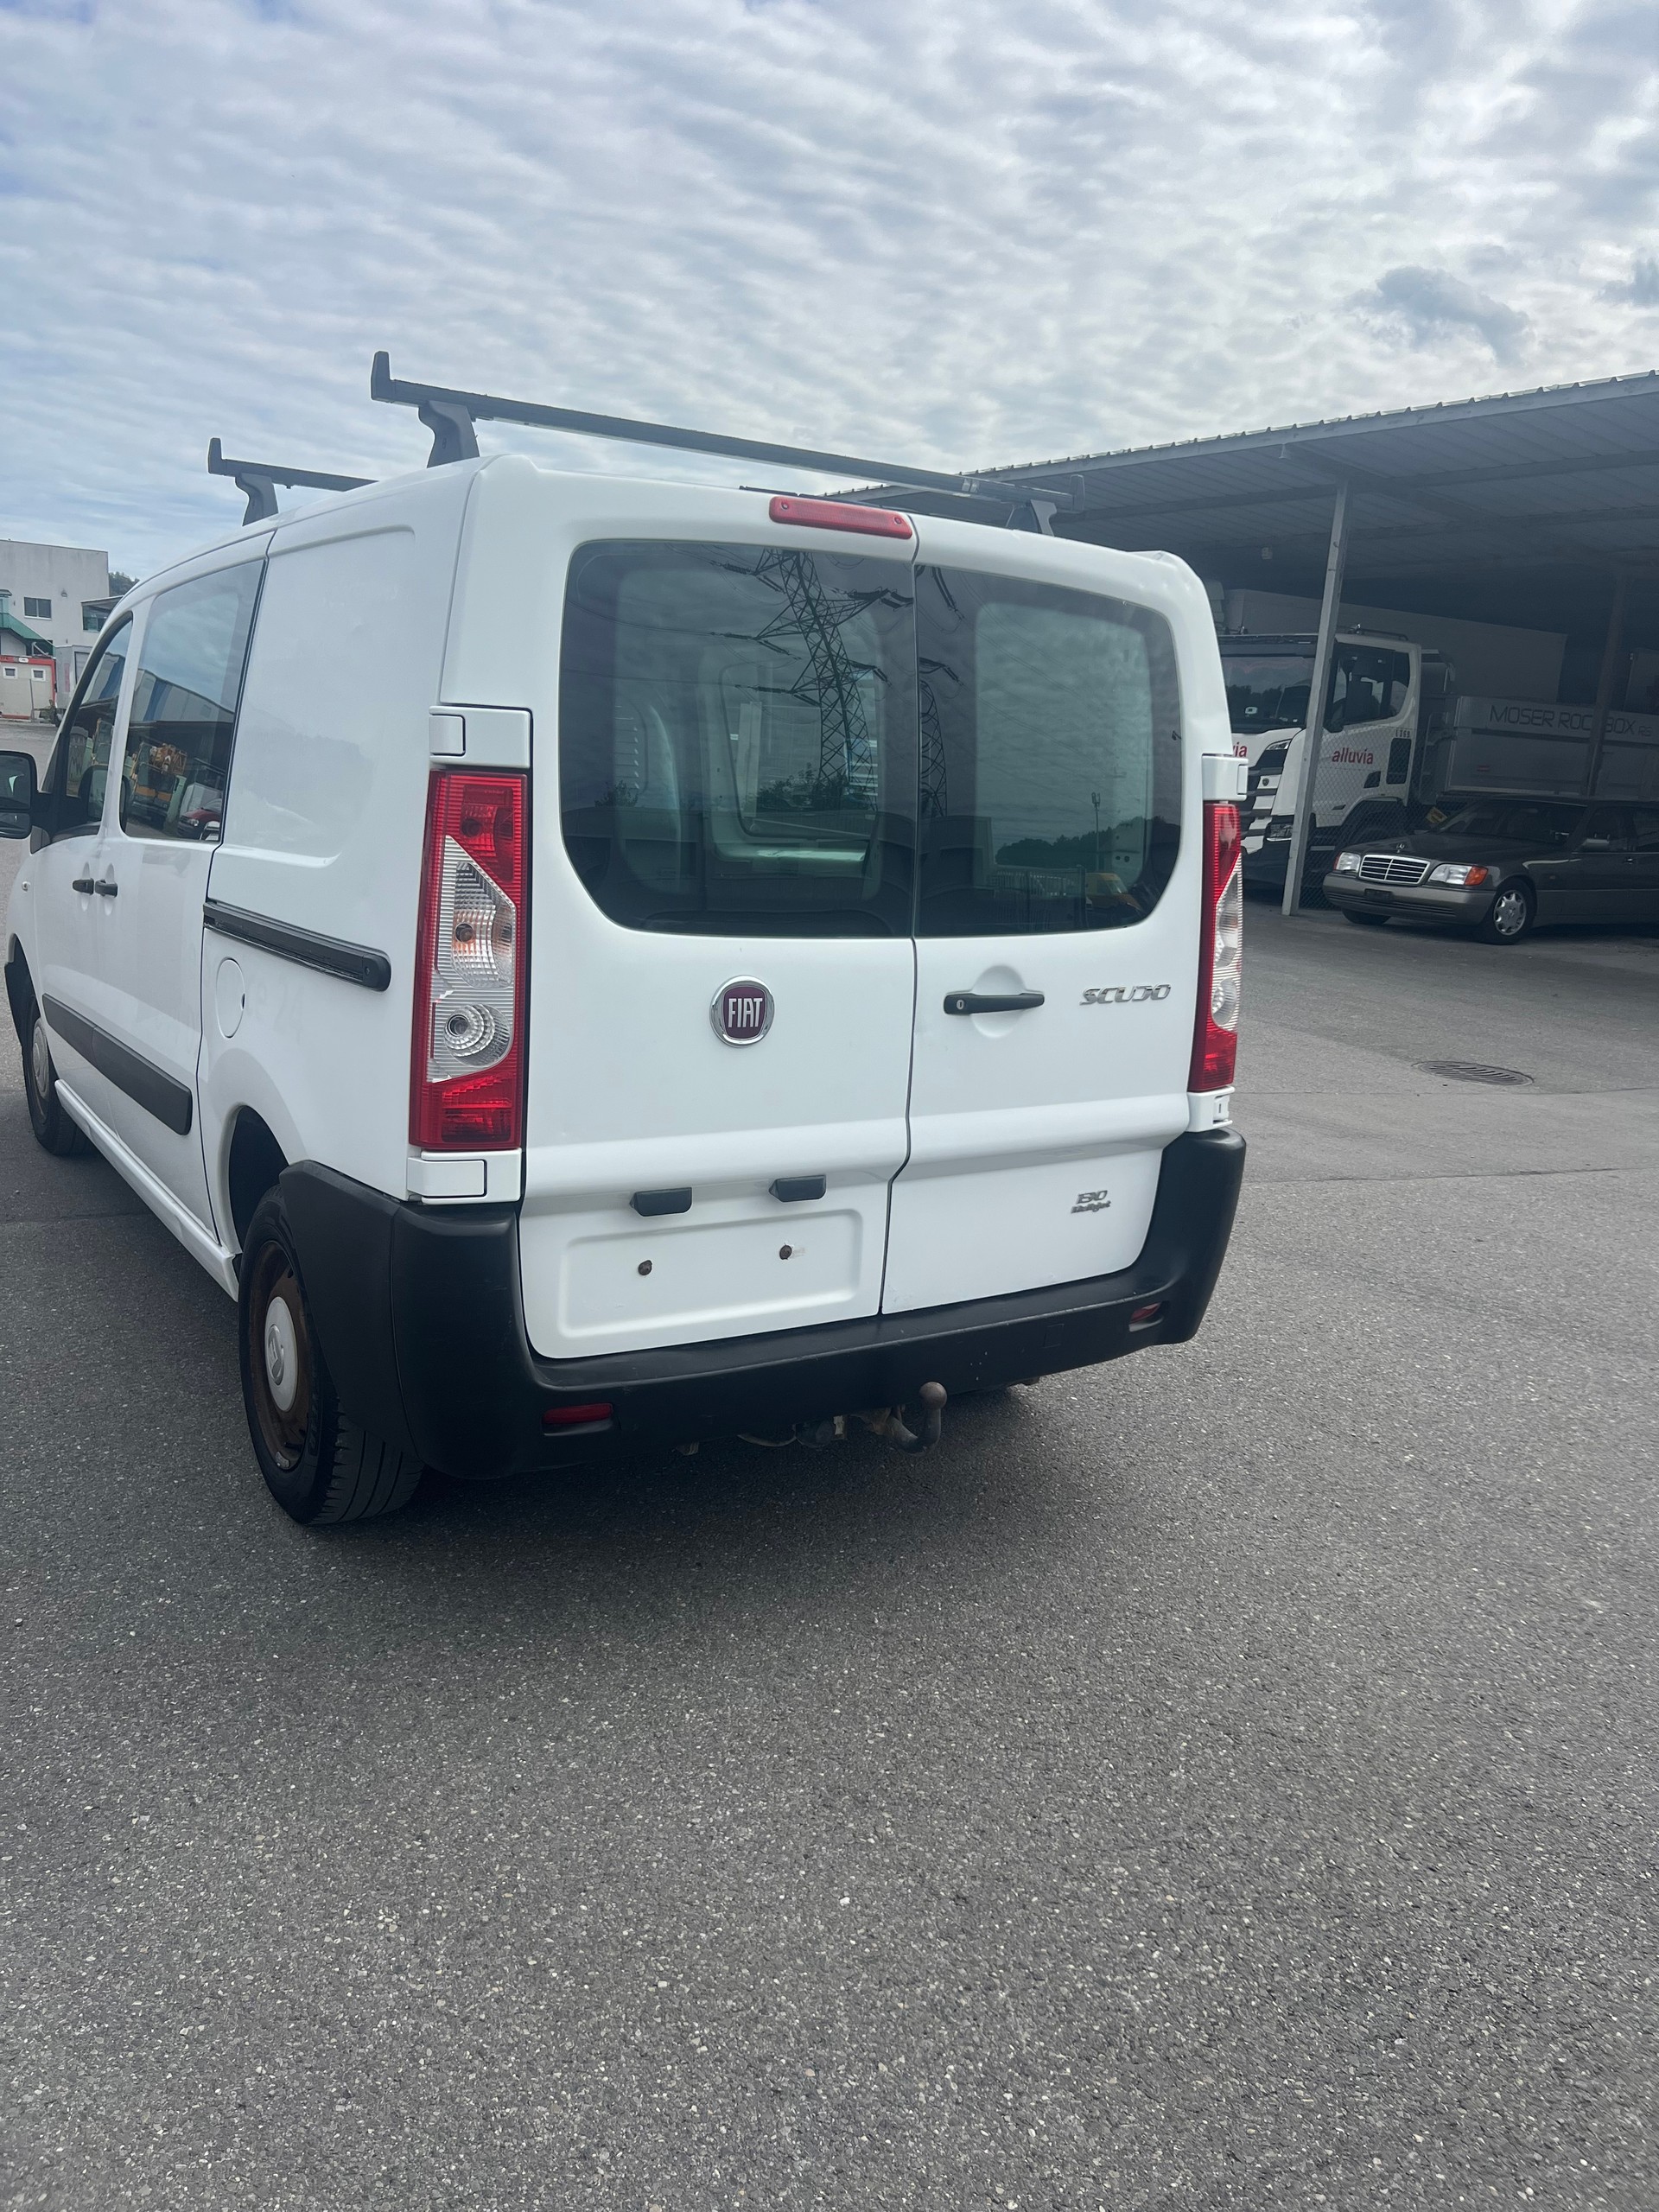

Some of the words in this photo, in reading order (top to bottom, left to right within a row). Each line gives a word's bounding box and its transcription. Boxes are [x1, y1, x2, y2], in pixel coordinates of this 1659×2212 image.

[1490, 705, 1554, 728] MOSER
[1558, 711, 1636, 734] ROCBOX
[1332, 747, 1374, 765] alluvia
[1079, 984, 1171, 1005] SCUDO
[728, 997, 763, 1028] FIAT
